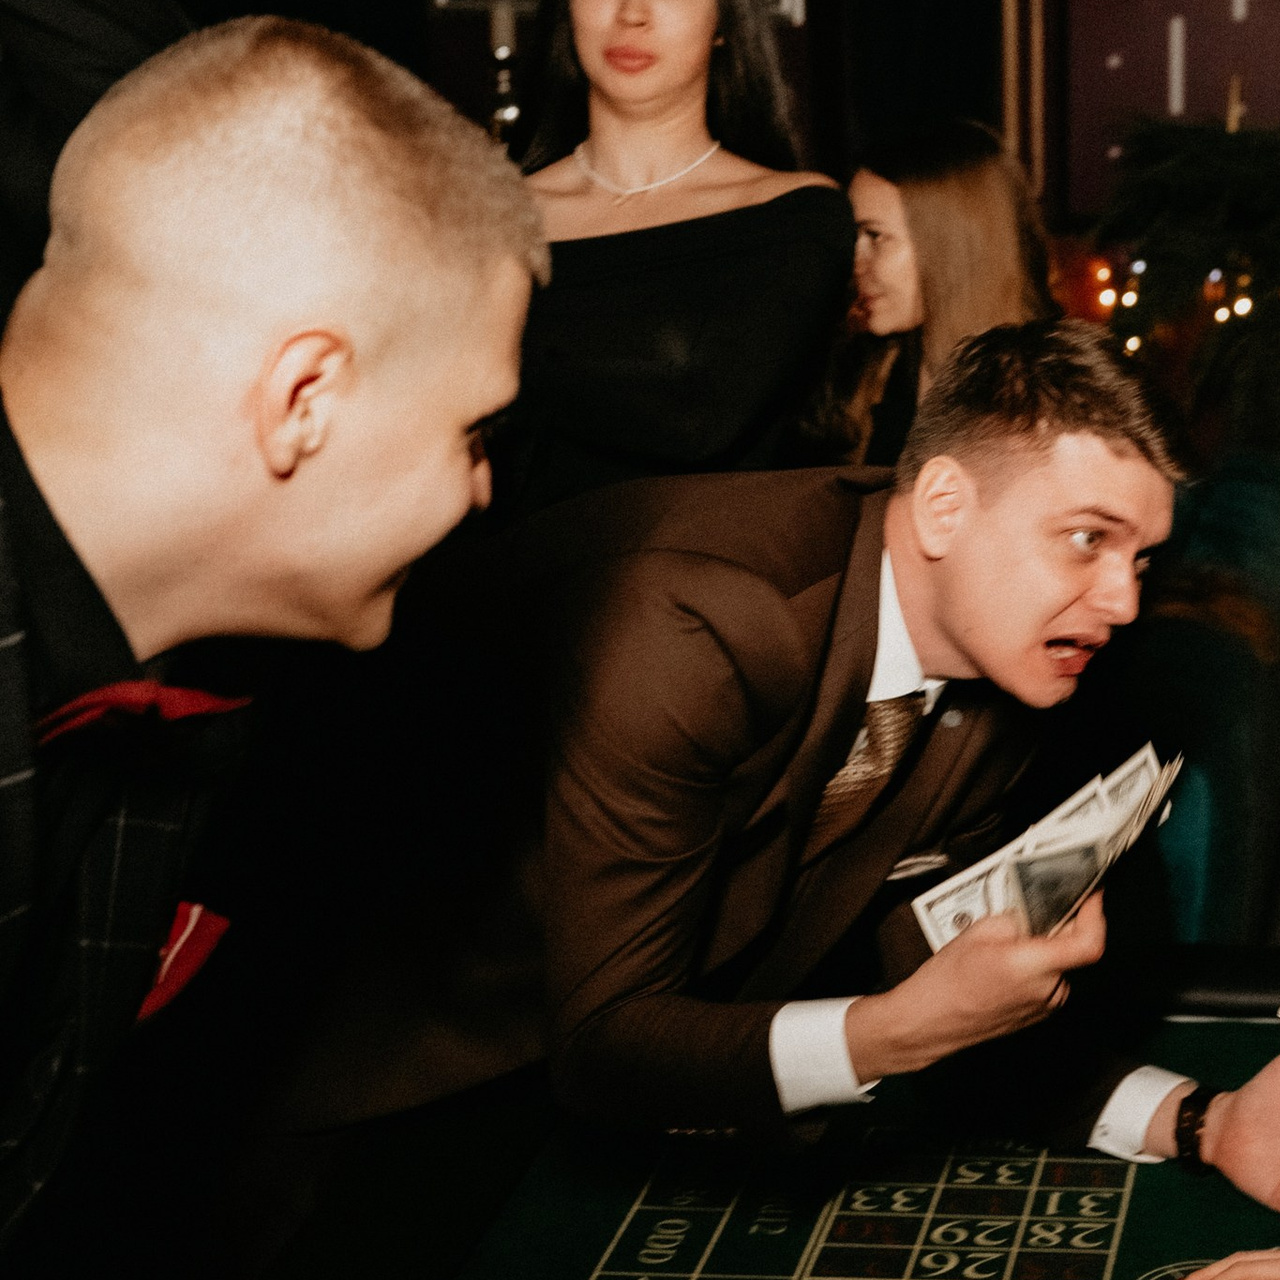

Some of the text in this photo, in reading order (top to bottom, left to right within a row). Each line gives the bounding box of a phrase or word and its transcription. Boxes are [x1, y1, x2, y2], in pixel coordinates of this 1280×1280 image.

[952, 1160, 1033, 1185] 35
[849, 1186, 929, 1212] 33
[1044, 1190, 1116, 1217] 31
[637, 1218, 691, 1265] ODD
[929, 1219, 1018, 1246] 29
[1026, 1222, 1111, 1249] 28
[919, 1251, 1007, 1280] 26
